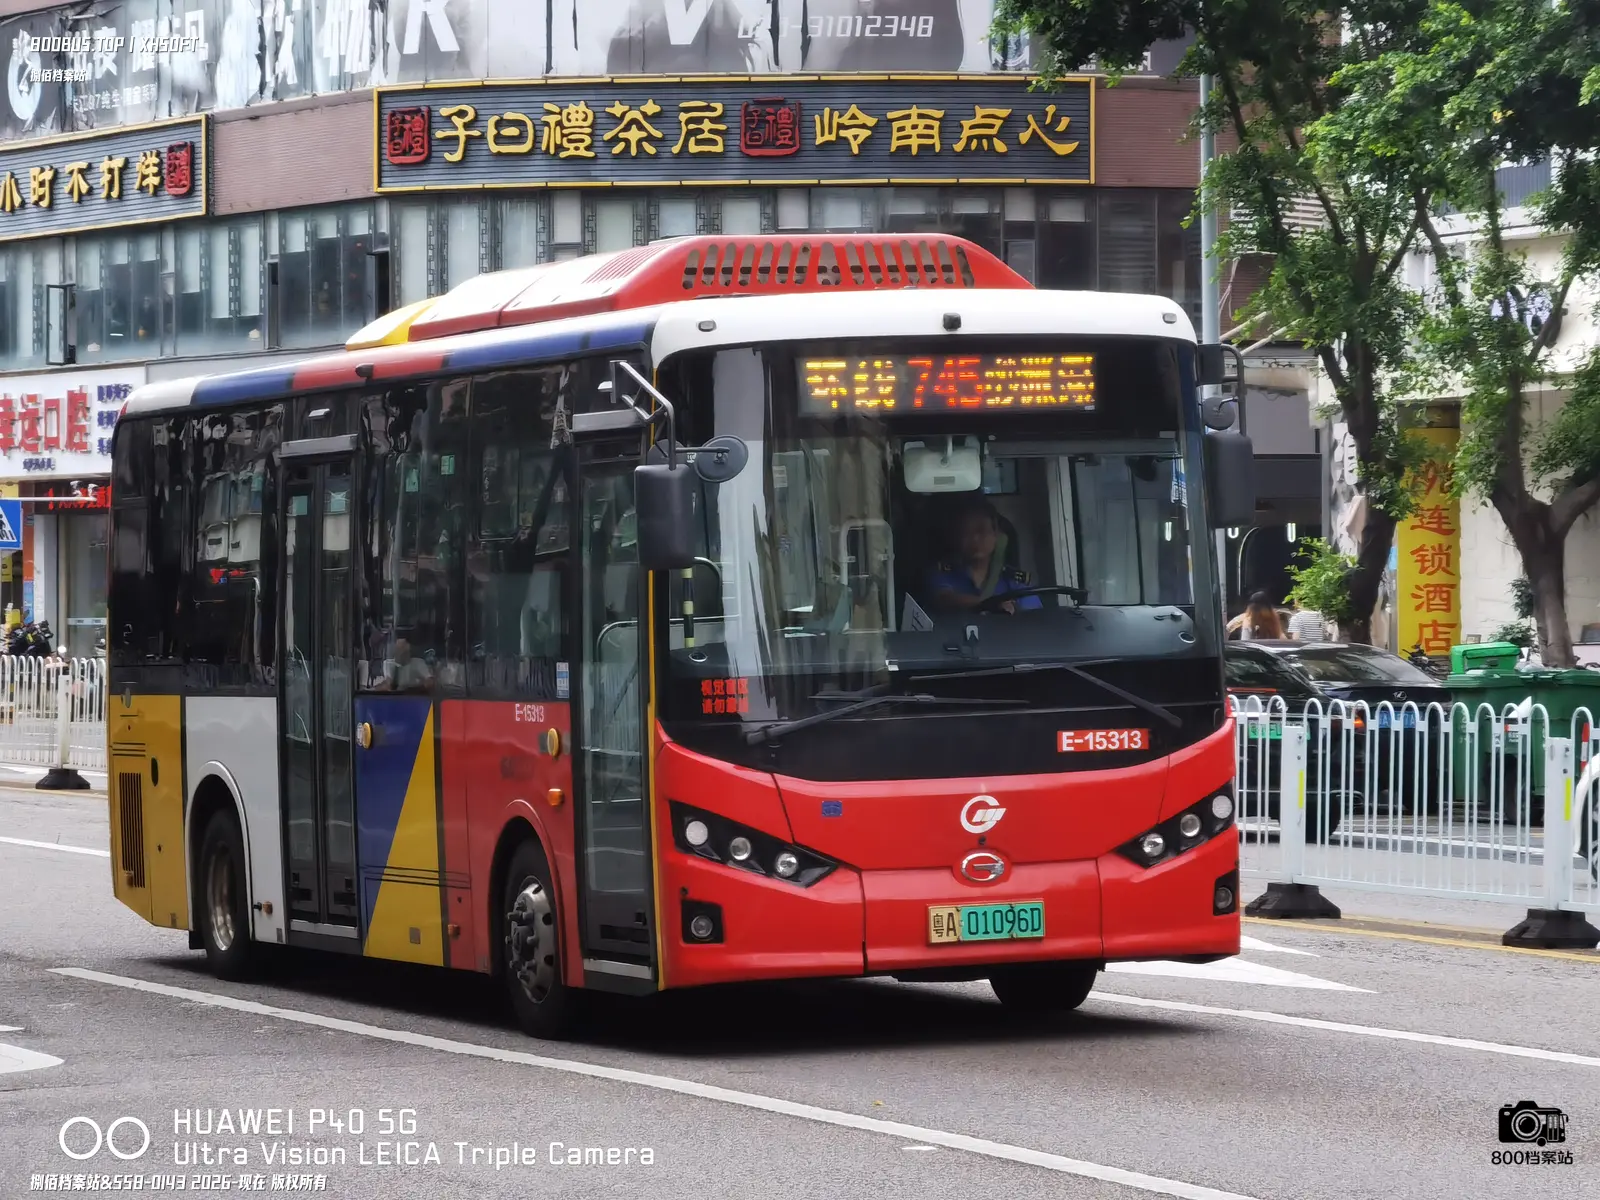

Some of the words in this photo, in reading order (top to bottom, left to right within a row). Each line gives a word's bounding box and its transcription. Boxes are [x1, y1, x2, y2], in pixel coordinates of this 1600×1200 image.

[814, 103, 1080, 156] 岭南点心
[0, 150, 161, 212] 小时不打烊
[908, 356, 984, 408] 745
[515, 703, 545, 723] E-15313
[1062, 730, 1142, 752] E-15313
